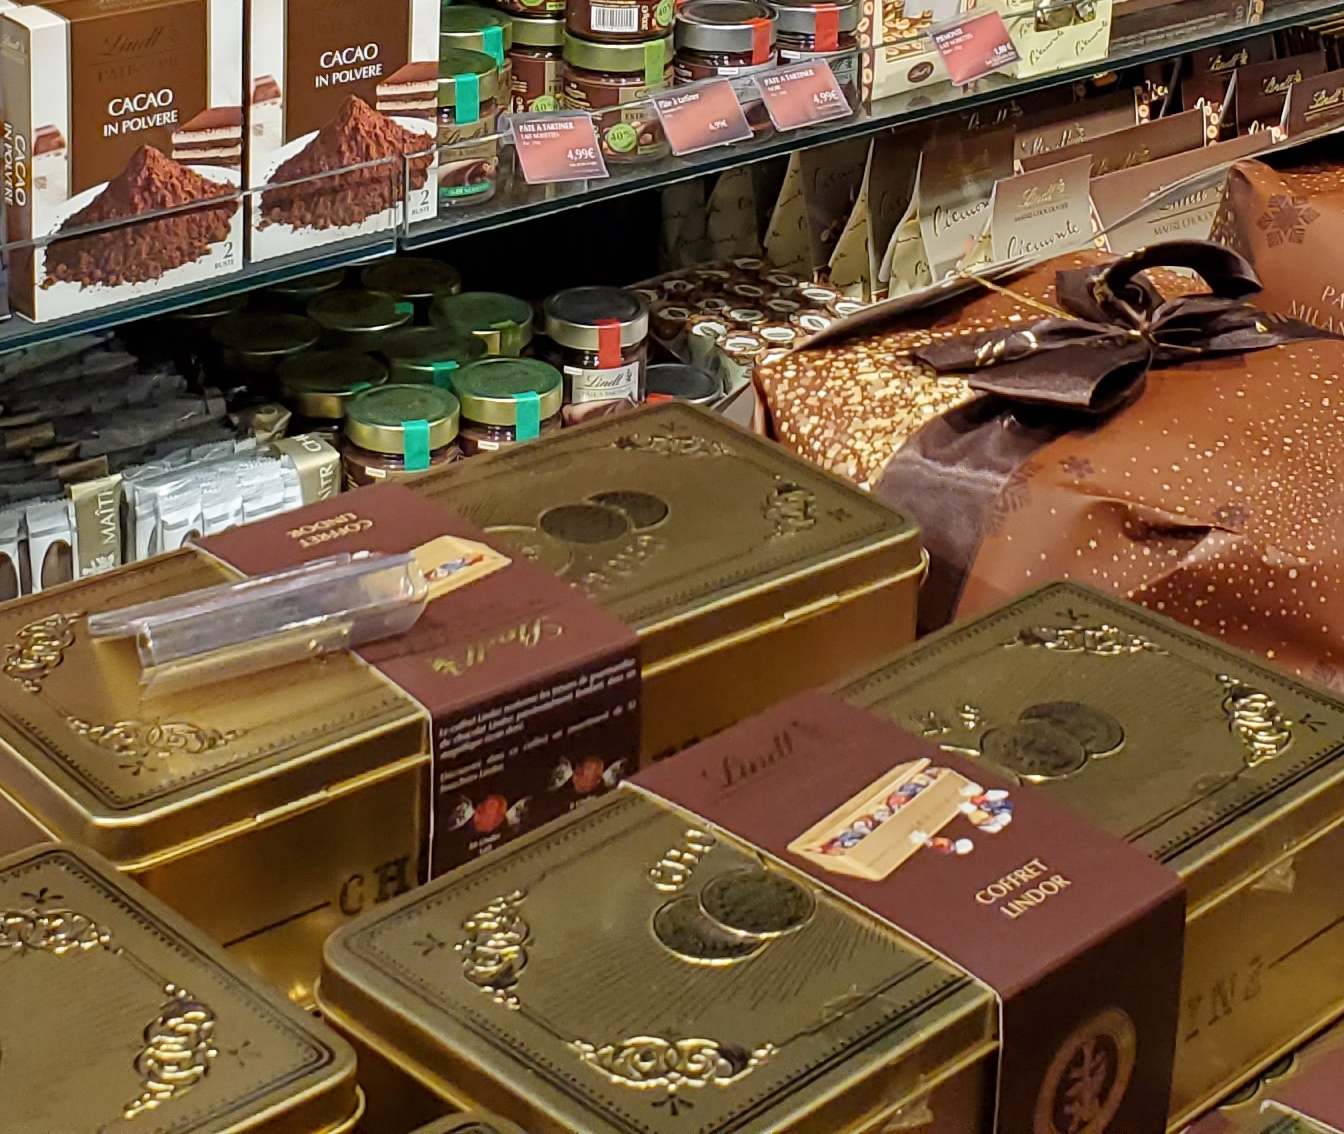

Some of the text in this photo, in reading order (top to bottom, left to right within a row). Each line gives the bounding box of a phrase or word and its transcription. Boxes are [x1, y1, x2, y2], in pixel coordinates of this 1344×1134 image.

[319, 43, 380, 69] CACAO
[314, 61, 384, 88] IN POLVERE
[108, 88, 174, 117] CACAO
[812, 90, 839, 105] 4,99€
[103, 108, 179, 137] IN POLVERE
[567, 148, 597, 161] 4,99€
[13, 133, 28, 208] CACAO
[420, 188, 431, 207] 2
[222, 240, 235, 260] 2
[1006, 219, 1082, 261] Piemonte
[584, 372, 624, 388] Lindt
[285, 511, 358, 538] LINDOR
[298, 518, 374, 549] COFFRET
[975, 857, 1049, 905] COFFRET
[999, 874, 1073, 919] LINDOR
